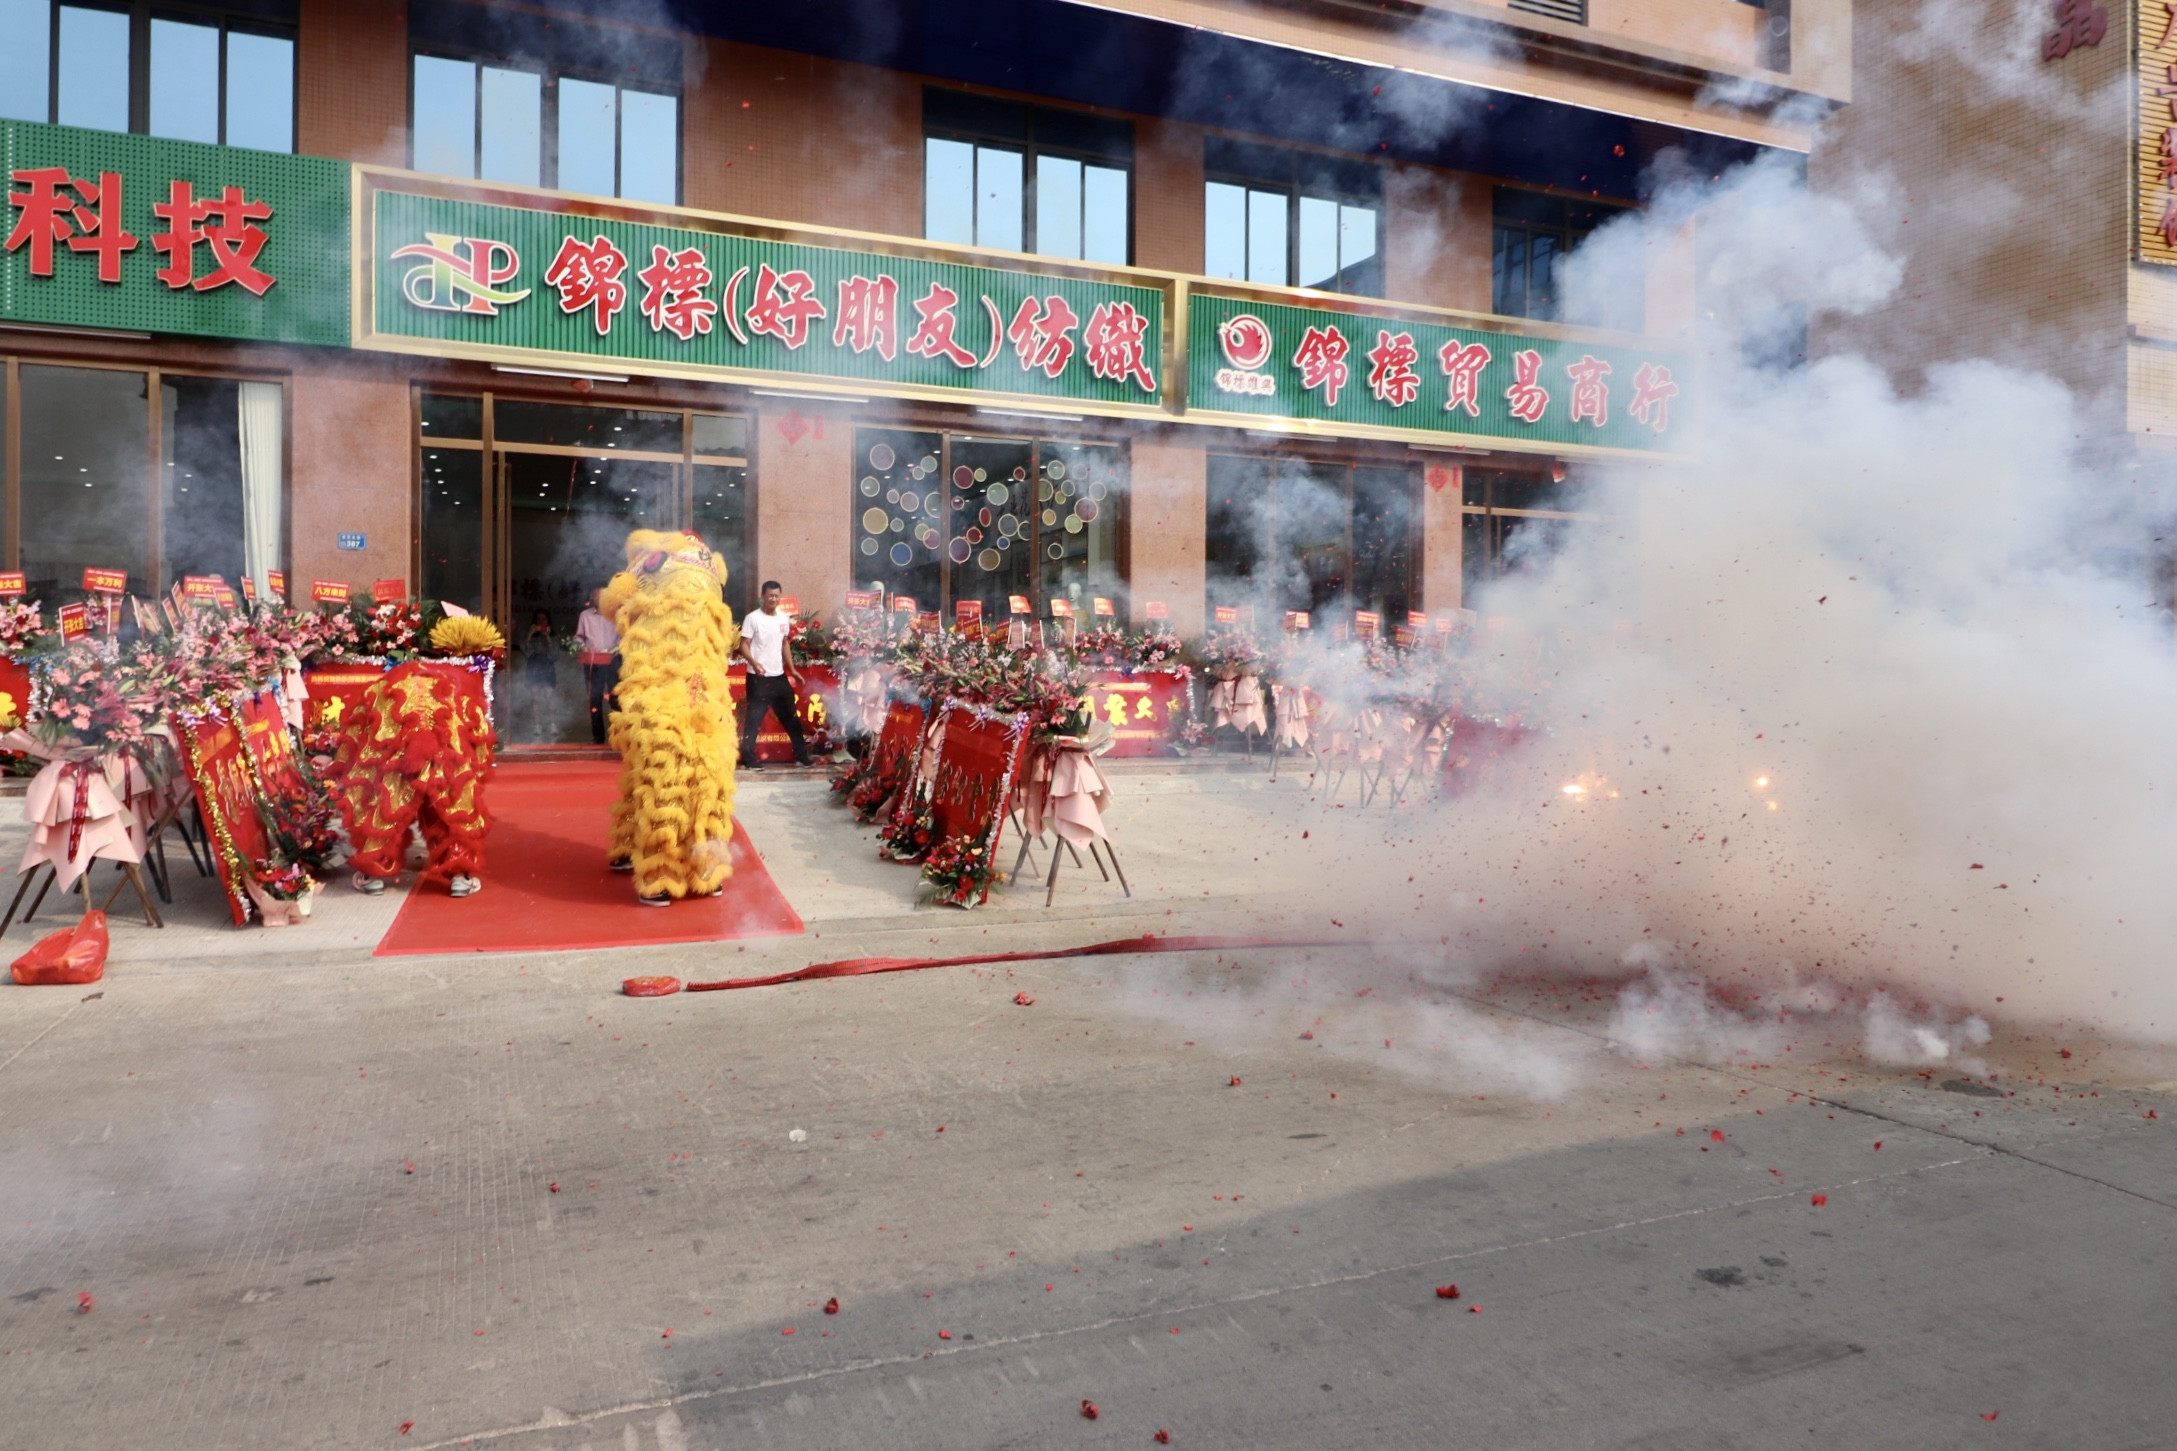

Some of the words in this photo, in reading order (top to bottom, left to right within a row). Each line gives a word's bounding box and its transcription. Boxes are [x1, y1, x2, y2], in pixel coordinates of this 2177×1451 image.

[4, 166, 277, 296] 科技
[1293, 324, 1680, 433] 錦標貿易商行
